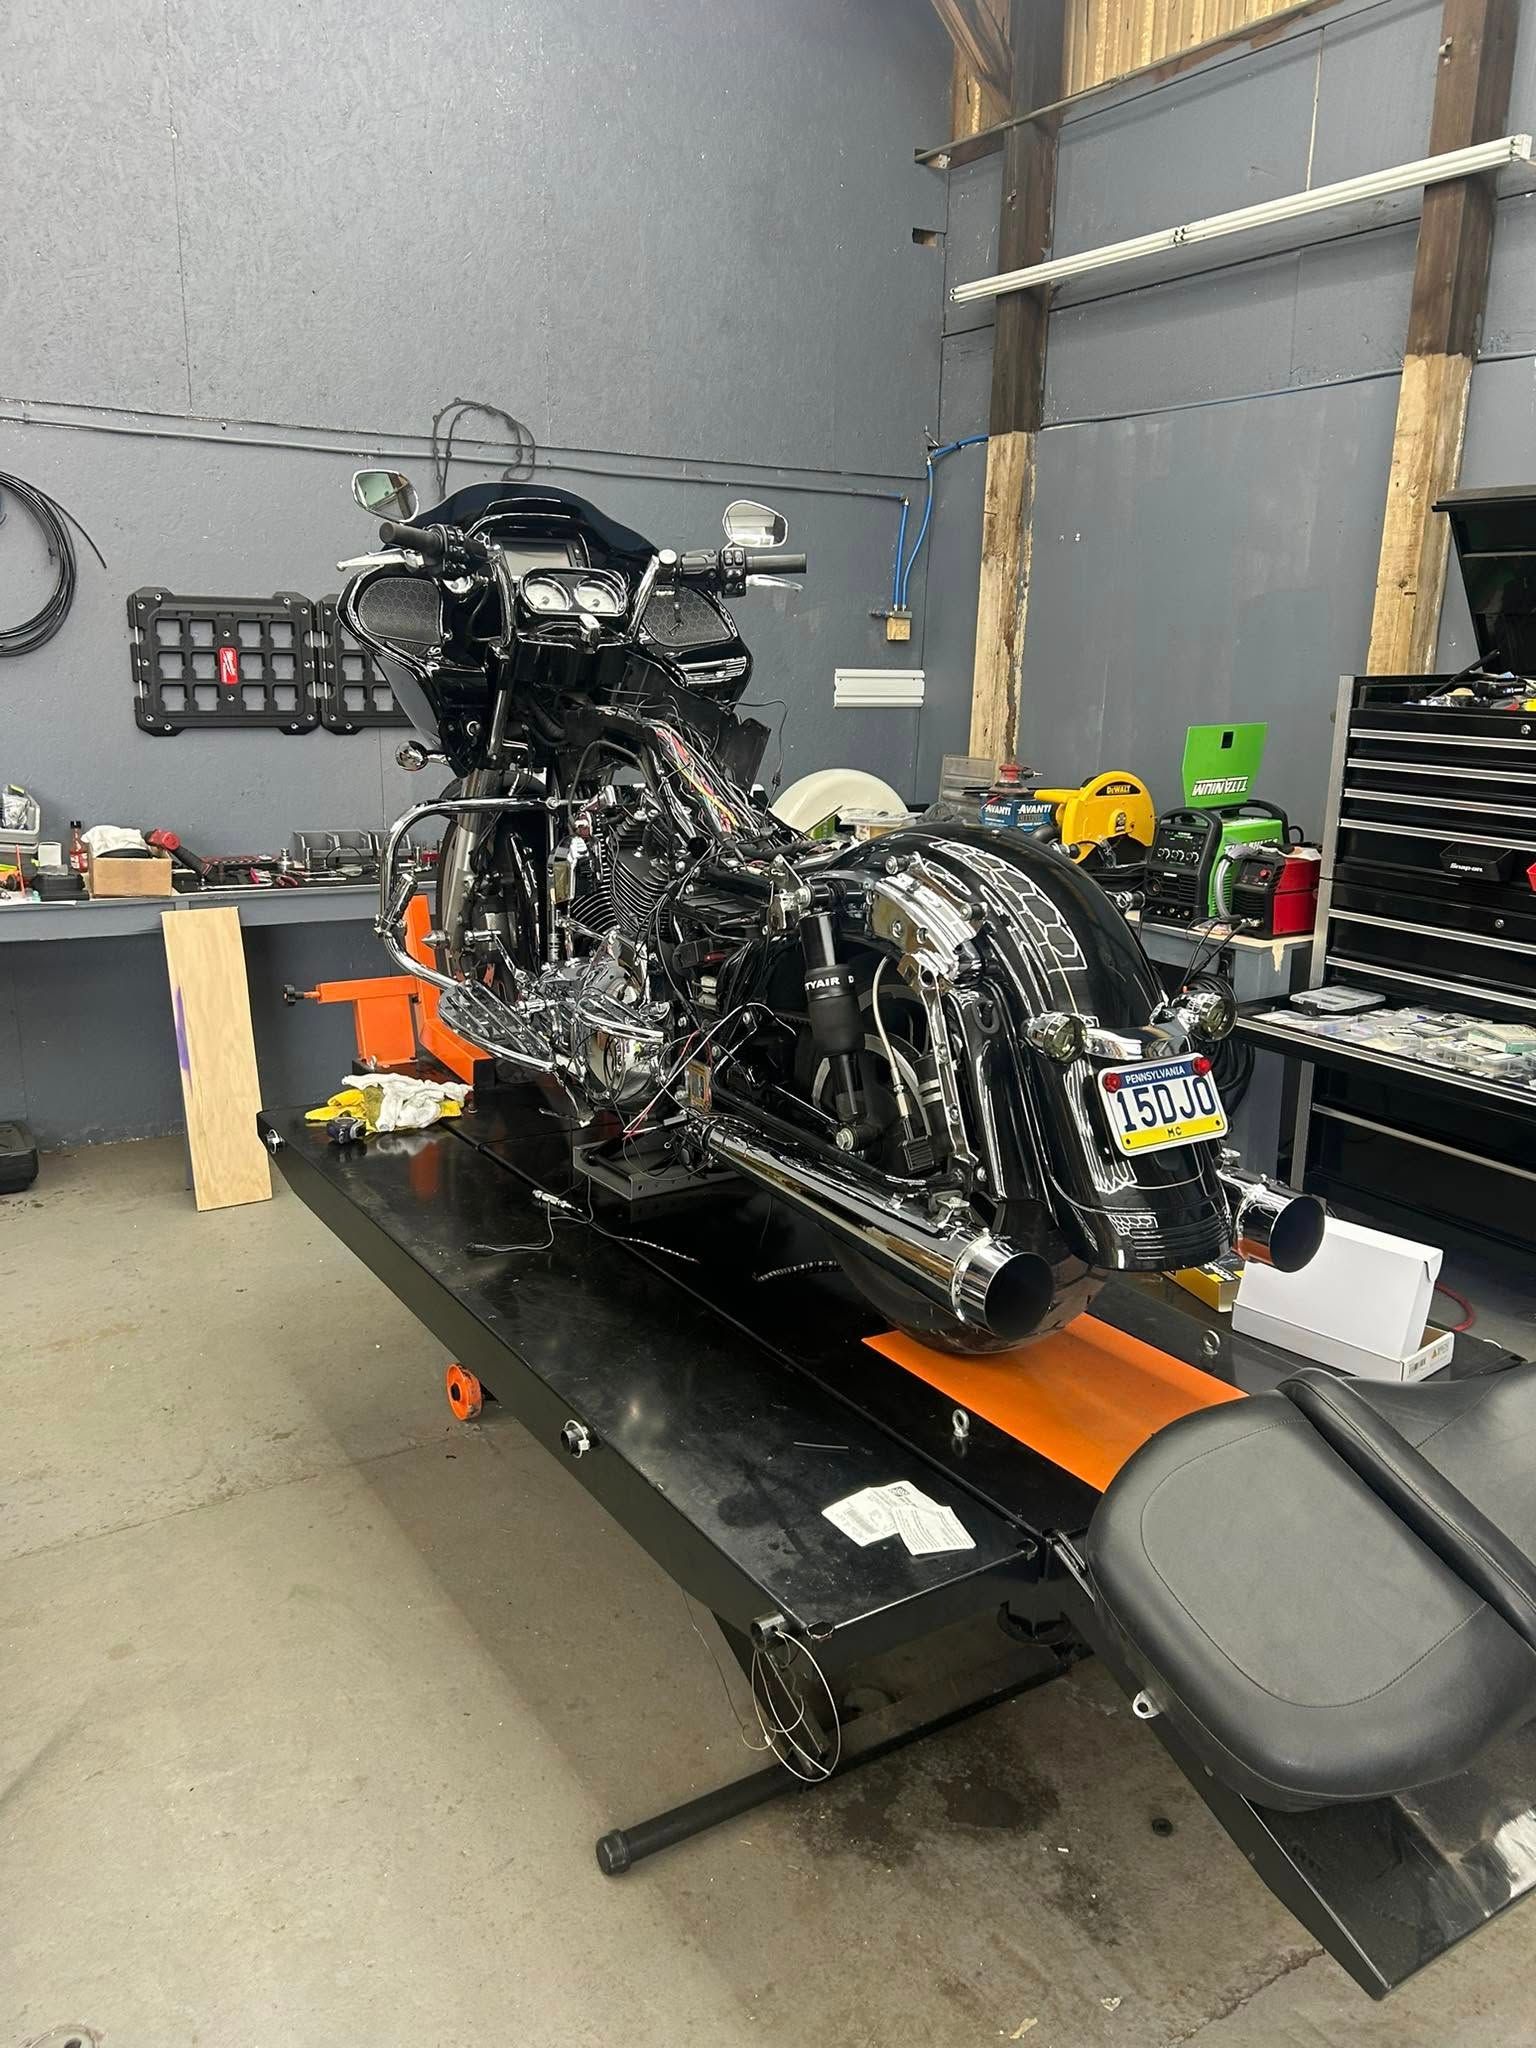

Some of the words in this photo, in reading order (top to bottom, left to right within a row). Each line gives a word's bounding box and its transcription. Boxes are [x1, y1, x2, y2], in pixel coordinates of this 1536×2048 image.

[1192, 777, 1249, 797] TITANIUM
[985, 804, 1012, 816] AVANTI
[1017, 804, 1052, 815] AVANTI
[1126, 1066, 1186, 1085] PENNSYLVANIA
[1167, 1126, 1182, 1138] MC
